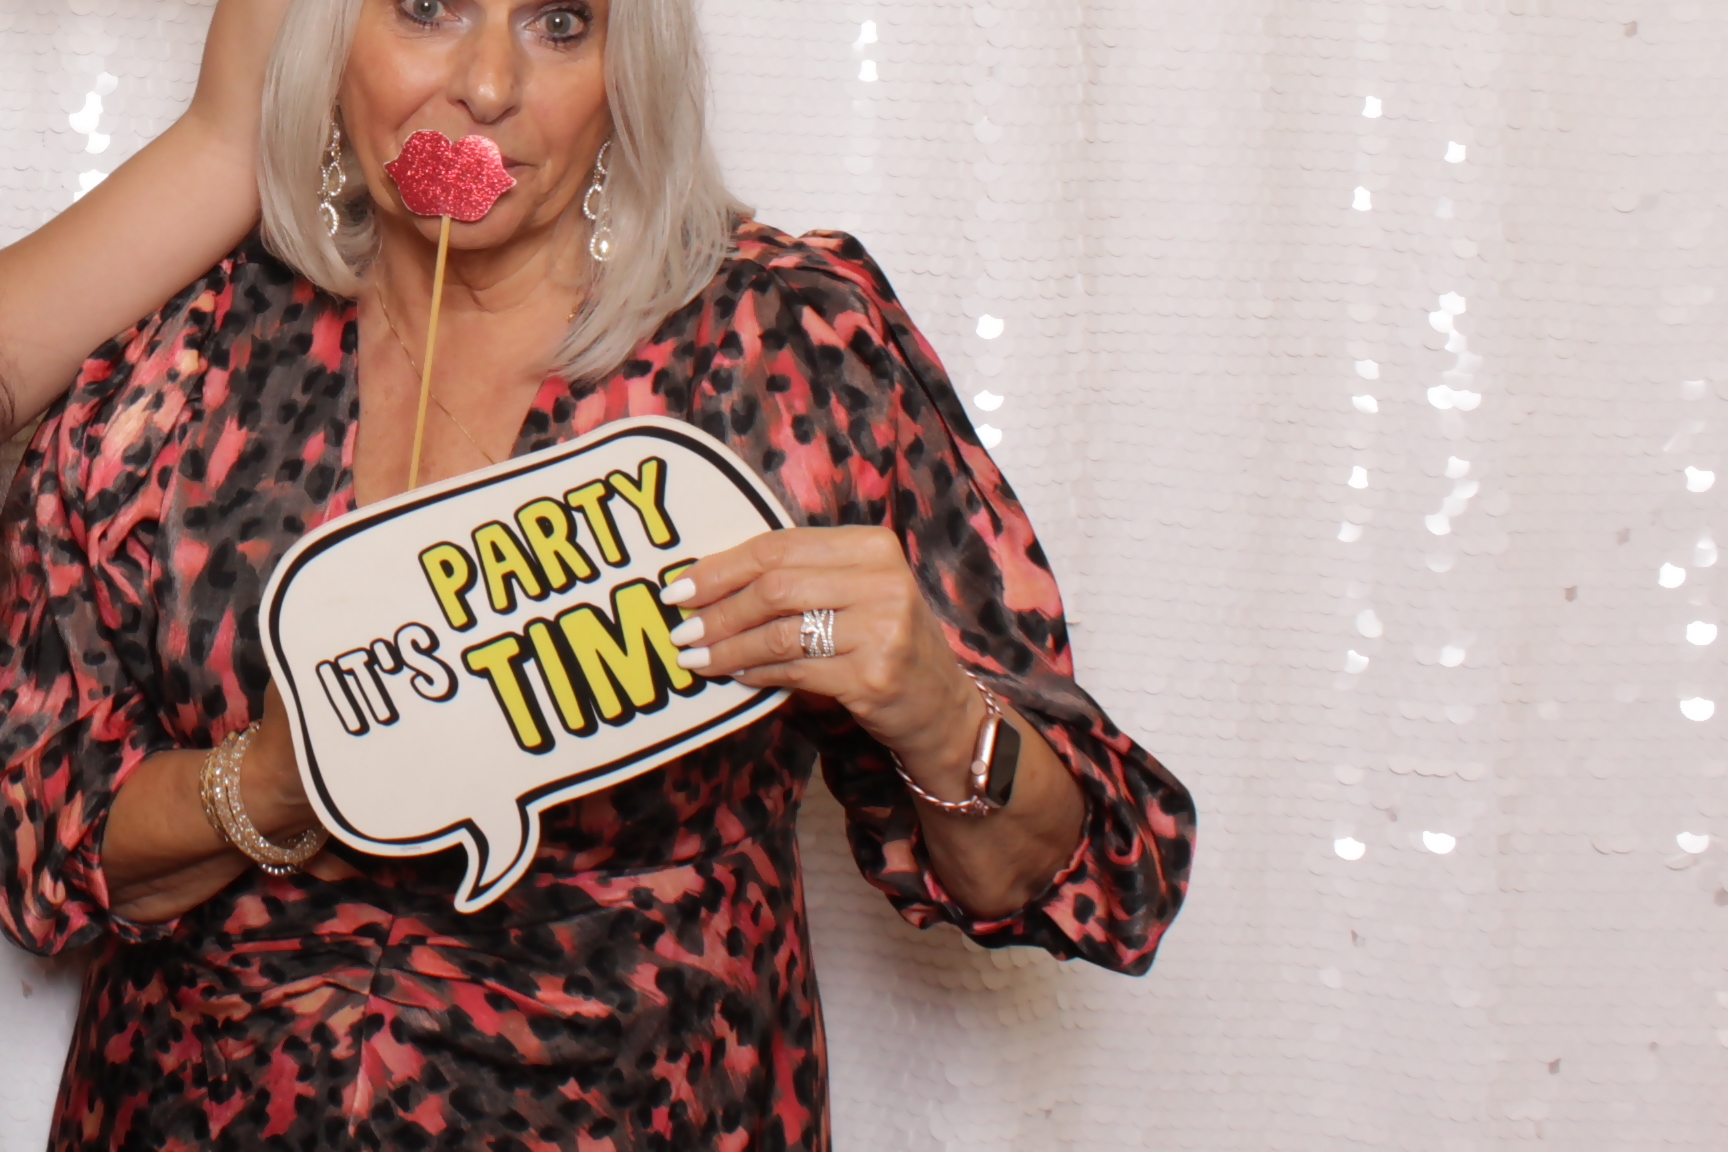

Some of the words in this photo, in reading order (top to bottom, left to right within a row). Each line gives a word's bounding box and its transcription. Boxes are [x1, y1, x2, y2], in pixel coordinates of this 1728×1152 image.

[419, 457, 680, 632] PARTY
[316, 622, 459, 736] IT'S
[462, 557, 734, 755] TIM
